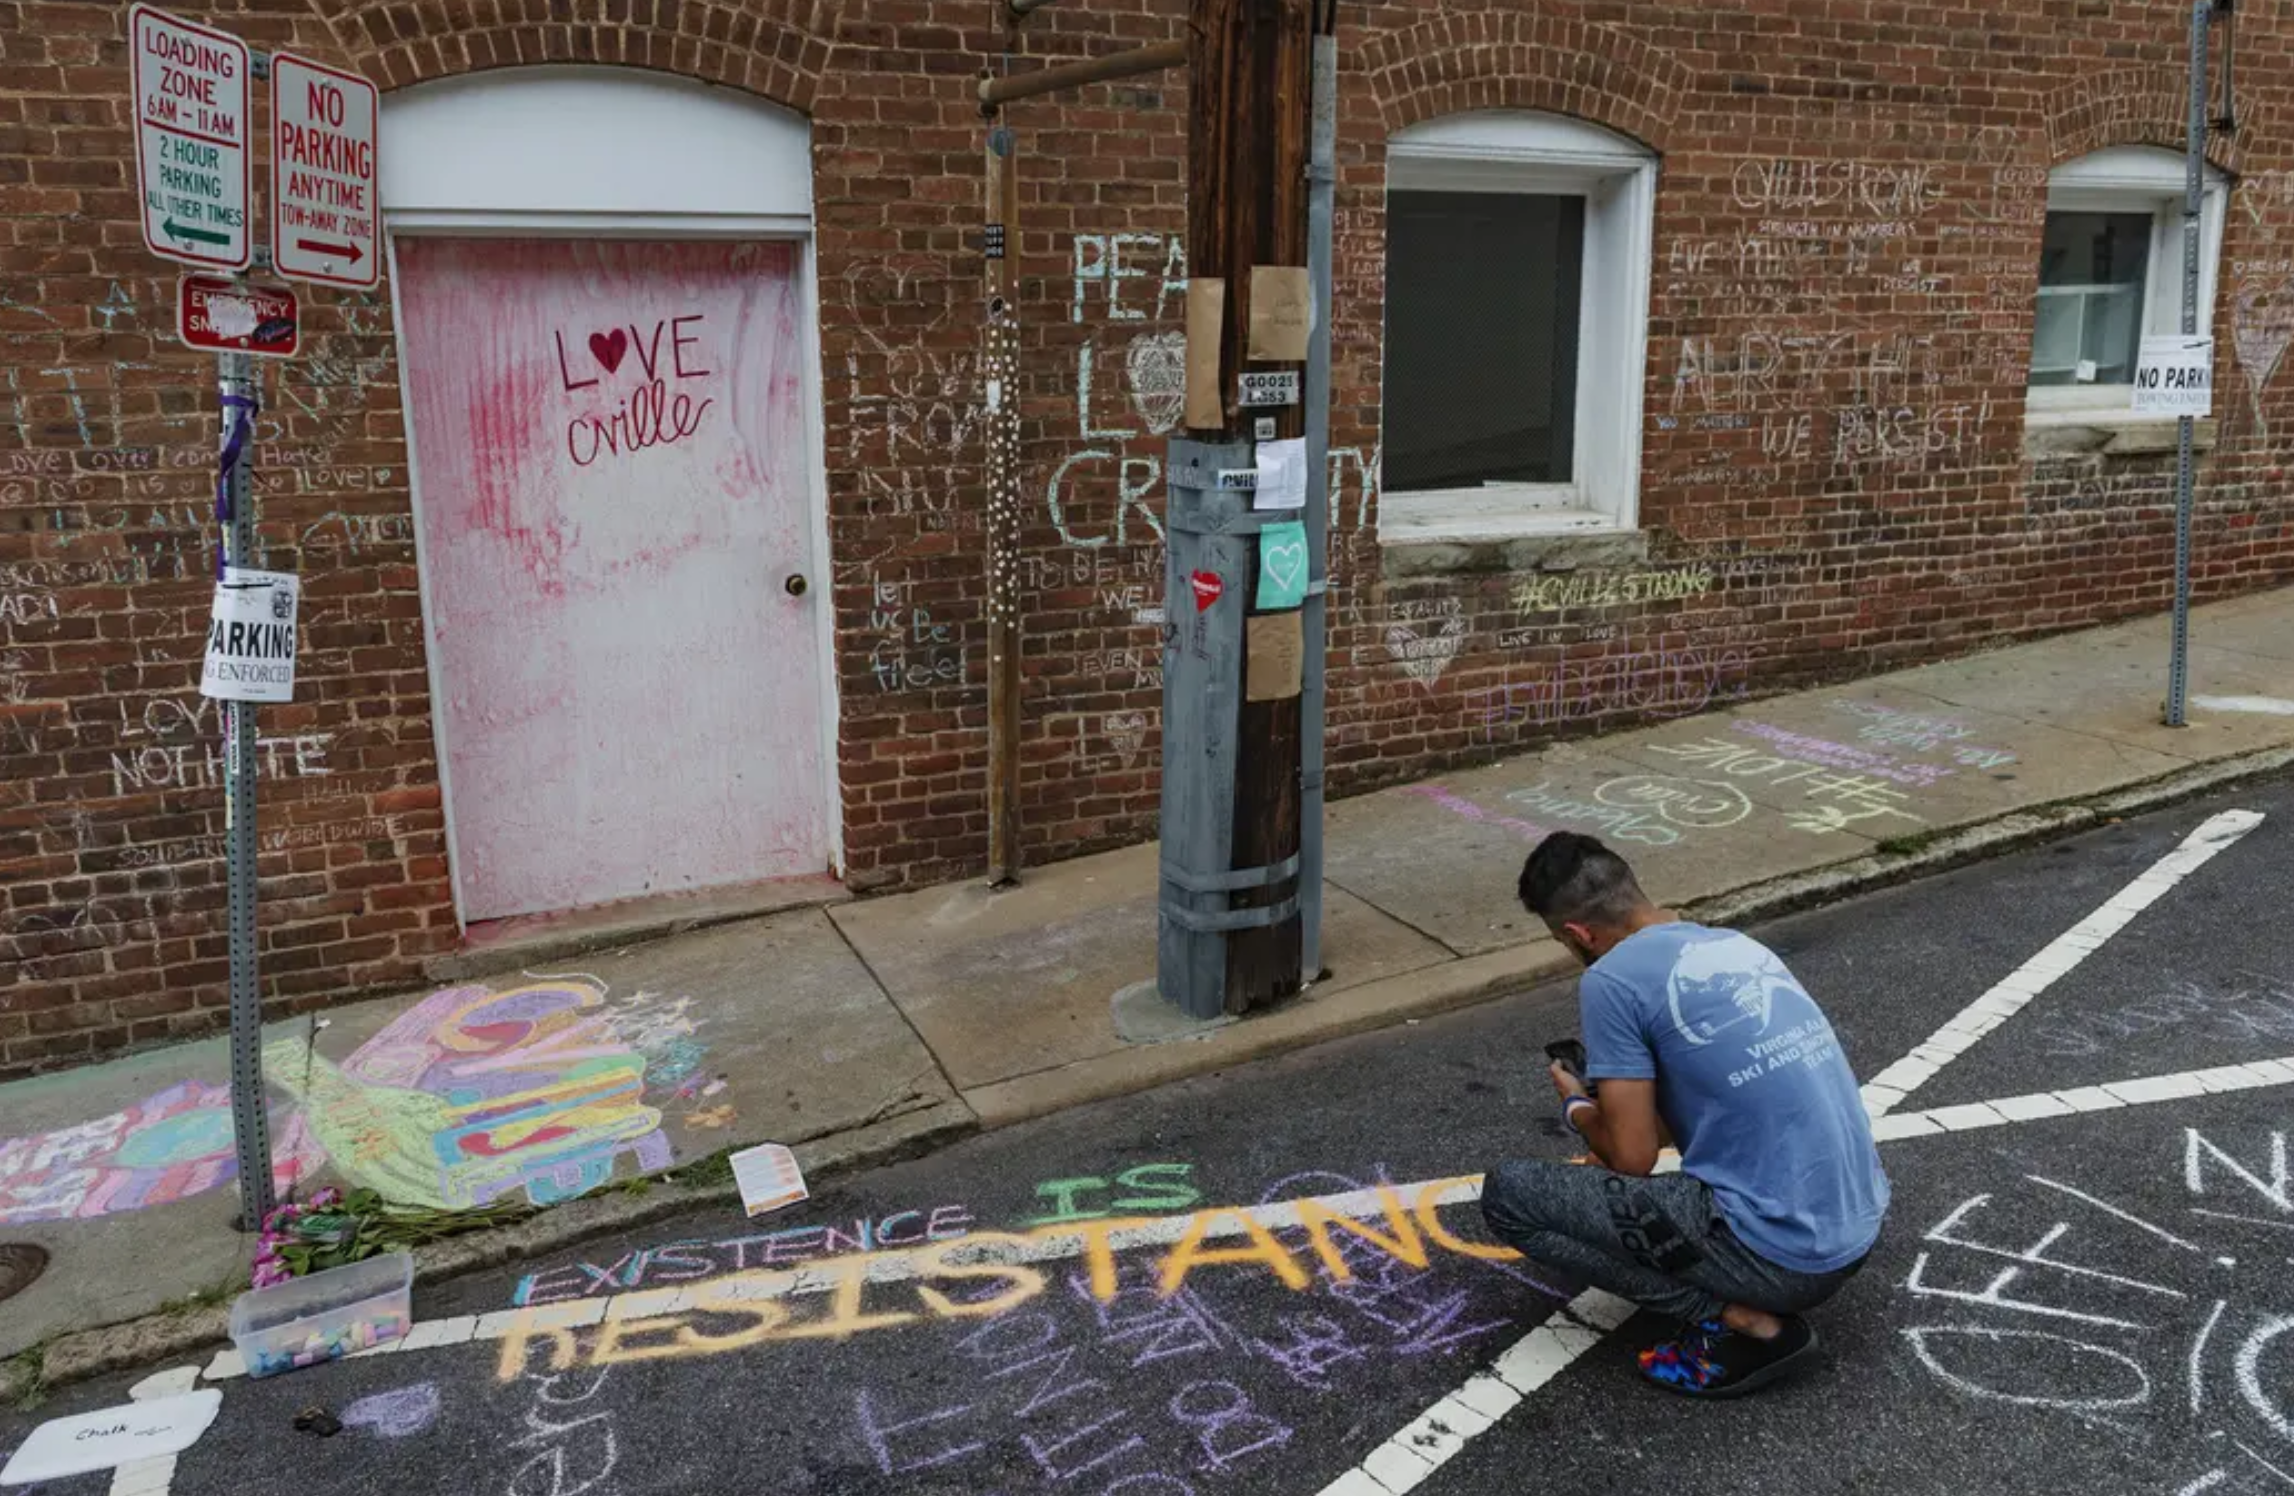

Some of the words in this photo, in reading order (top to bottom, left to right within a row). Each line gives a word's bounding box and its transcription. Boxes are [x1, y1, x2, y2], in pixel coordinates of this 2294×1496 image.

[145, 26, 234, 78] LOADING
[160, 67, 217, 106] ZONE
[308, 81, 344, 127] NO
[160, 135, 169, 159] 2
[174, 138, 219, 169] HOUR
[281, 121, 371, 180] PARKING
[160, 165, 222, 199] PARKING
[288, 172, 365, 212] ANYTIME
[147, 191, 167, 208] ALL
[168, 194, 202, 221] OTHER
[207, 202, 244, 228] TIMES
[281, 202, 338, 235] TOW-AWAY
[343, 214, 371, 240] ZONE
[1073, 234, 1188, 322] PEA
[2138, 368, 2159, 389] NO
[2165, 368, 2210, 389] PARK
[218, 661, 290, 684] ENFORCED
[111, 742, 195, 796] NOT
[1728, 1063, 1765, 1088] SKI
[1767, 1047, 1801, 1071] AND
[514, 1205, 975, 1307] EXISTENCE
[1018, 1163, 1200, 1229] IS
[494, 1172, 1526, 1382] RESISTANC
[75, 1423, 128, 1441] Chalk
